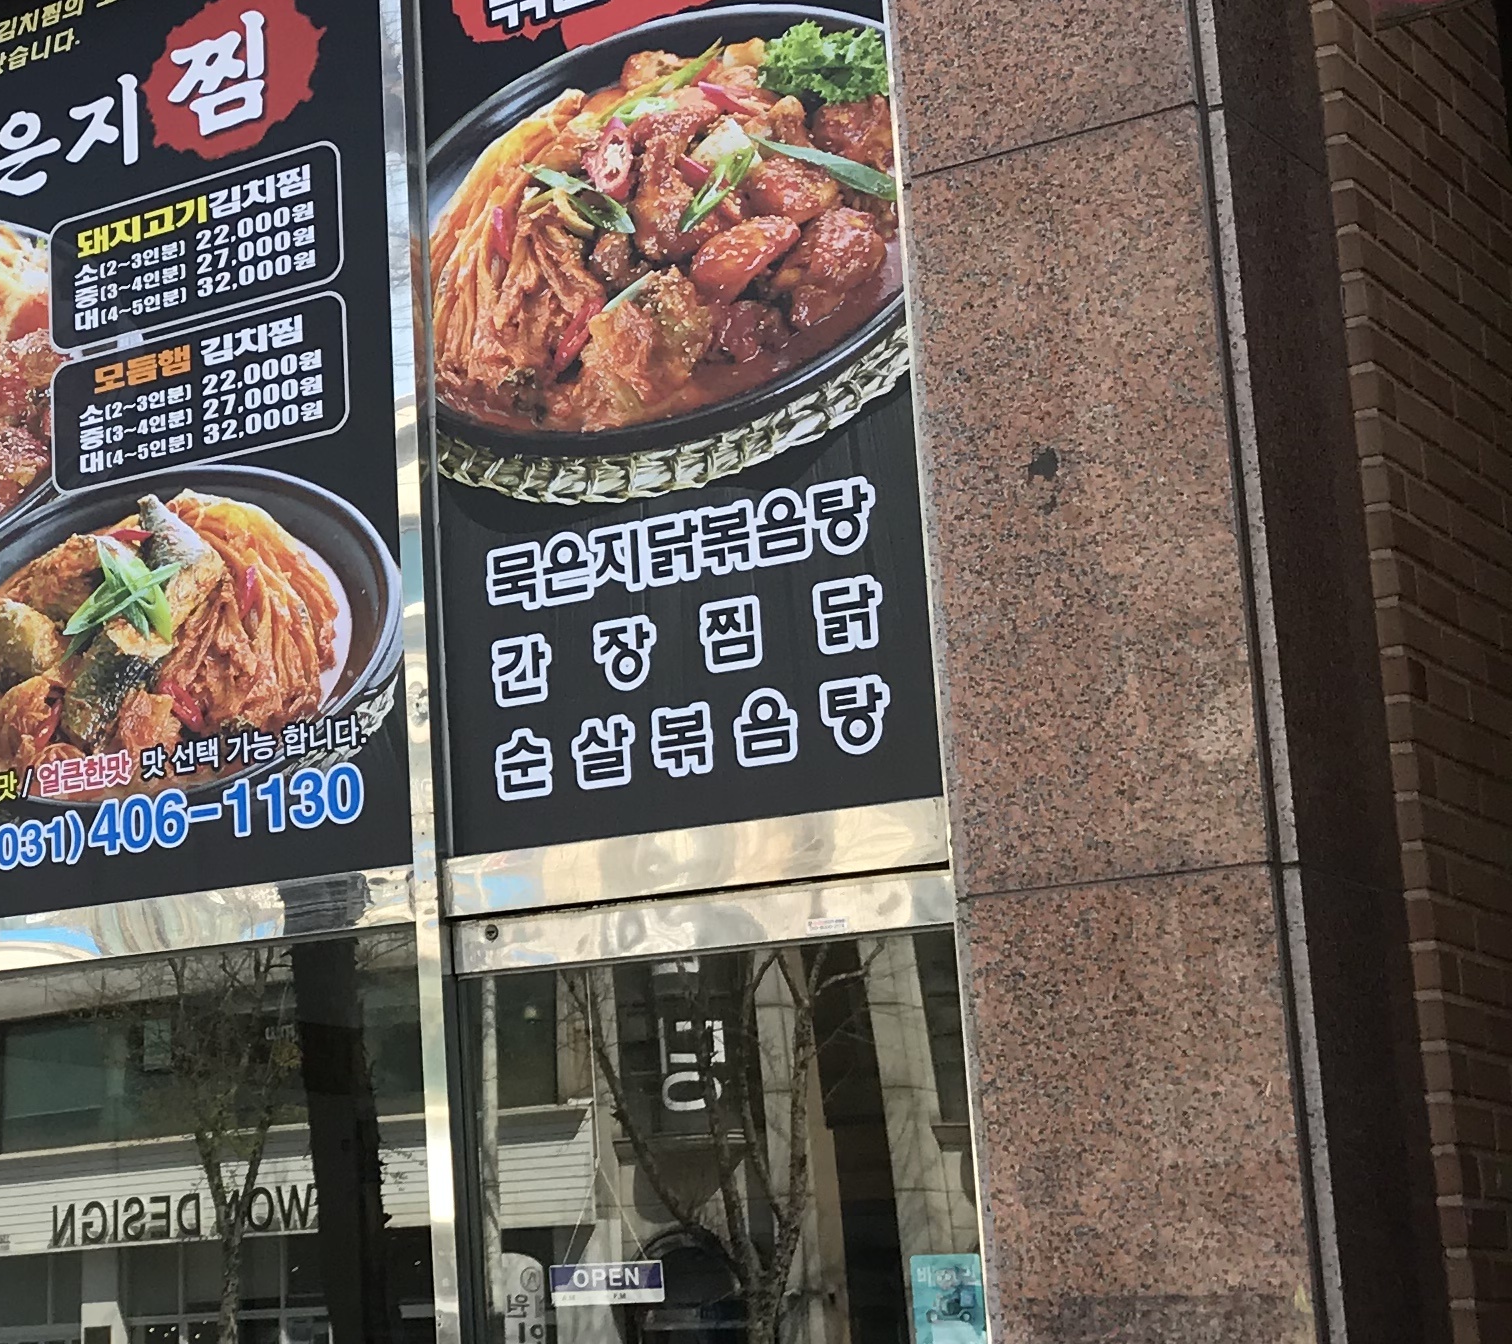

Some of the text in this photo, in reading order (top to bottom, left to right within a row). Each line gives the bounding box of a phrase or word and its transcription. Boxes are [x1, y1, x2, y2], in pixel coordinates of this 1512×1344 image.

[167, 9, 268, 138] 찜
[195, 201, 315, 252] 22,000원
[196, 225, 315, 275] 27,000원
[196, 249, 316, 298] 32,000원
[94, 314, 303, 394] 모듬햄 김치찜
[201, 349, 322, 396] 22,000원
[202, 373, 323, 422] 27,000원
[202, 399, 324, 446] 32,000원
[486, 476, 876, 611] 묵은지닭볶음탕
[36, 751, 132, 796] 얼큰한맛
[142, 751, 167, 780] 맛
[170, 739, 220, 774] 선택
[572, 1265, 641, 1289] OPEN
